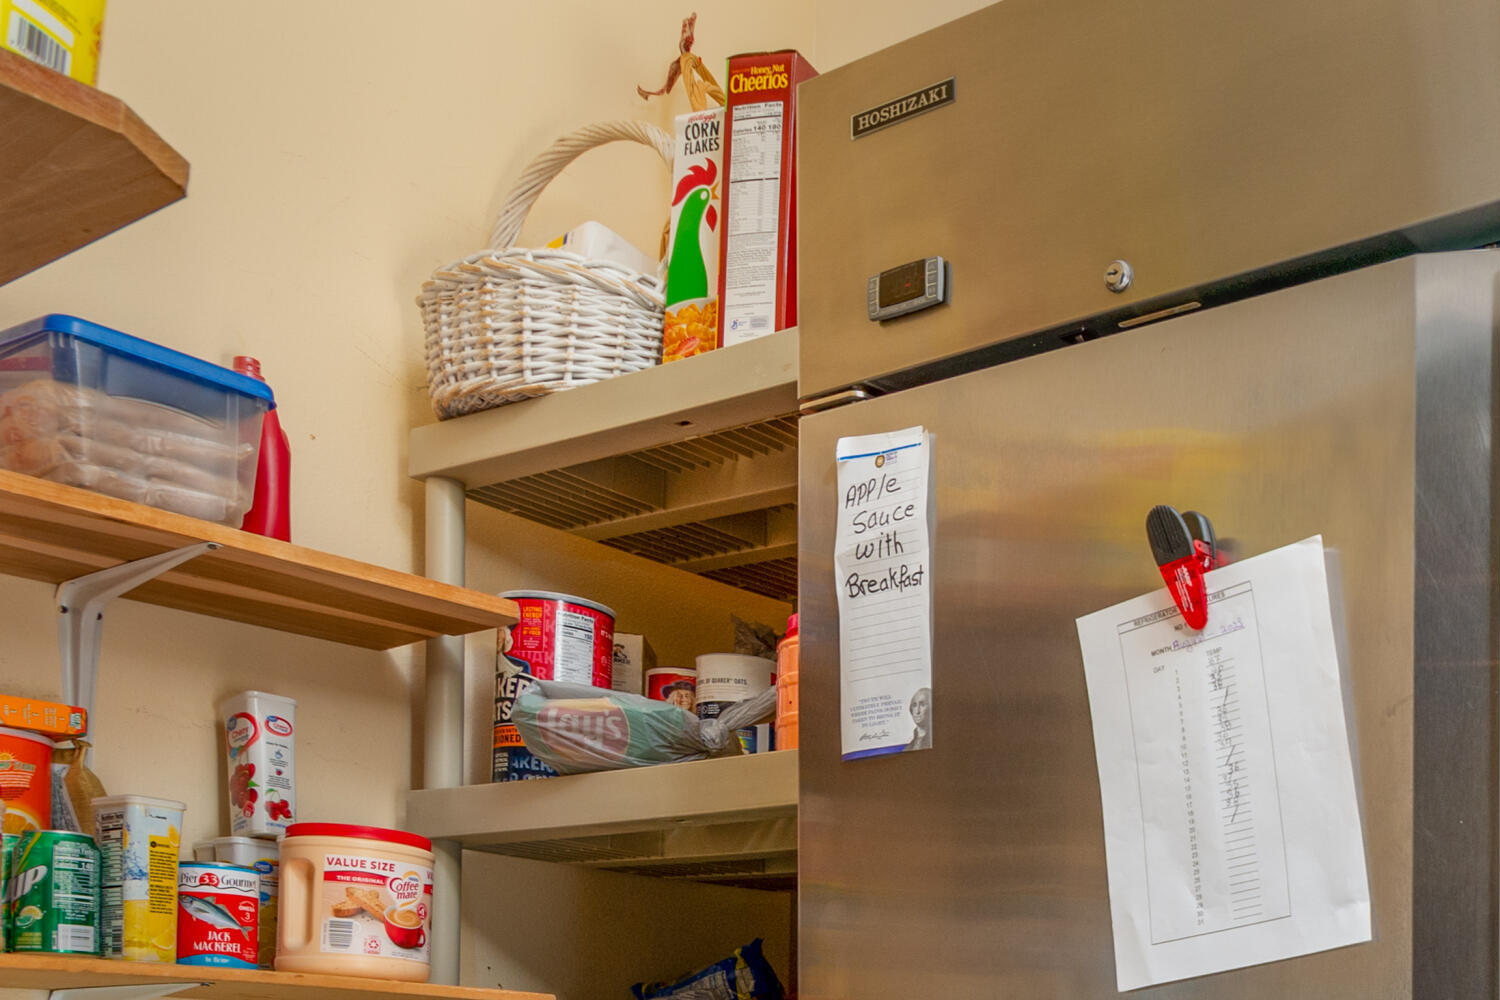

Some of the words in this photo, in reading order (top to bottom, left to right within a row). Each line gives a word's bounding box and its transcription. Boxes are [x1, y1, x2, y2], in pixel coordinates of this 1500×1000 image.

[730, 73, 788, 94] Cheerios
[857, 85, 948, 131] HOSHIZAKI
[685, 121, 720, 141] CORN
[684, 138, 720, 156] FLAKES
[845, 564, 924, 598] Breakfast
[1150, 645, 1173, 657] MONTH
[326, 857, 367, 868] VALUE
[370, 861, 396, 872] SIZE
[180, 871, 198, 884] Pier
[201, 874, 218, 885] 33
[336, 874, 350, 882] THE
[351, 876, 385, 885] ORIGINAL
[389, 877, 420, 894] Coffee
[396, 892, 418, 900] mate
[245, 912, 251, 920] 3
[207, 931, 232, 942] JACK
[194, 941, 242, 955] MACKEREL
